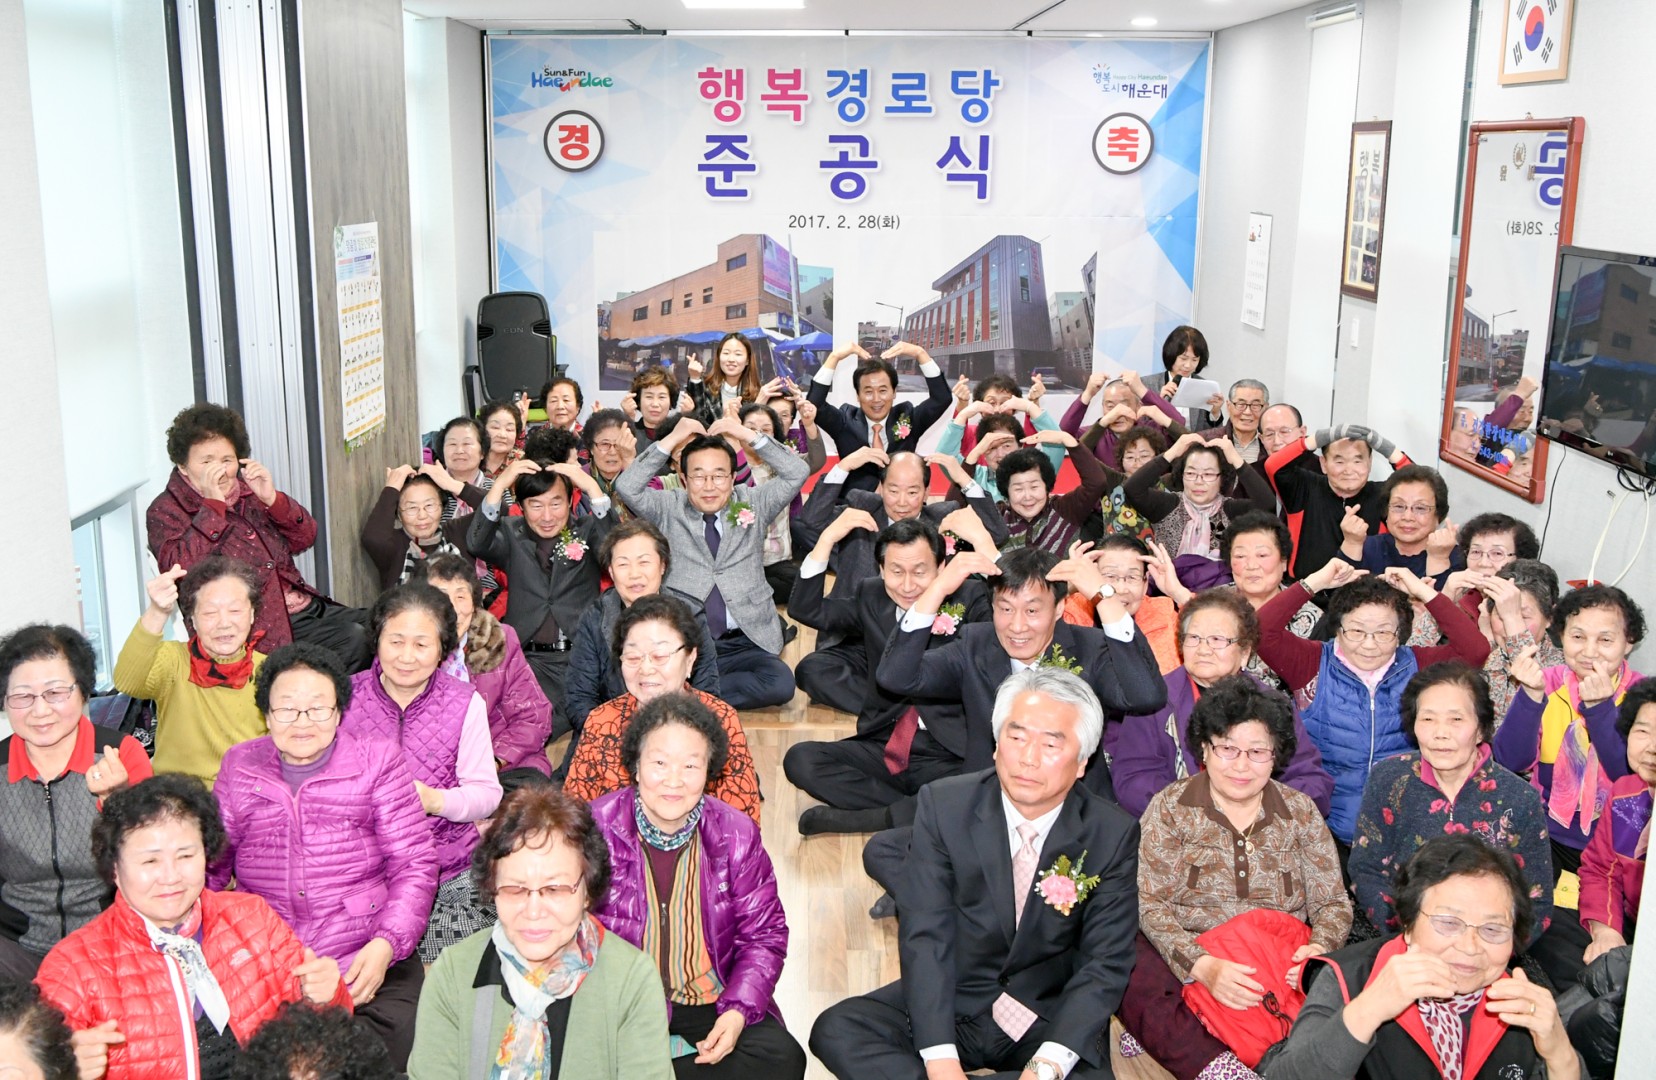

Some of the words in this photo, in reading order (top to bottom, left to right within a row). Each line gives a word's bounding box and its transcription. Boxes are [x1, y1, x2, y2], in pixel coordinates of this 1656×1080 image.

[544, 68, 586, 77] Sun&Fun
[1093, 71, 1111, 84] 행복
[531, 71, 614, 92] Haeundae
[1102, 83, 1120, 93] 도시
[1121, 83, 1168, 99] 해운대
[557, 125, 589, 161] 경
[1107, 126, 1139, 162] 축
[788, 215, 830, 229] 2017.
[837, 215, 851, 229] 2.
[858, 214, 901, 230] 28(화)
